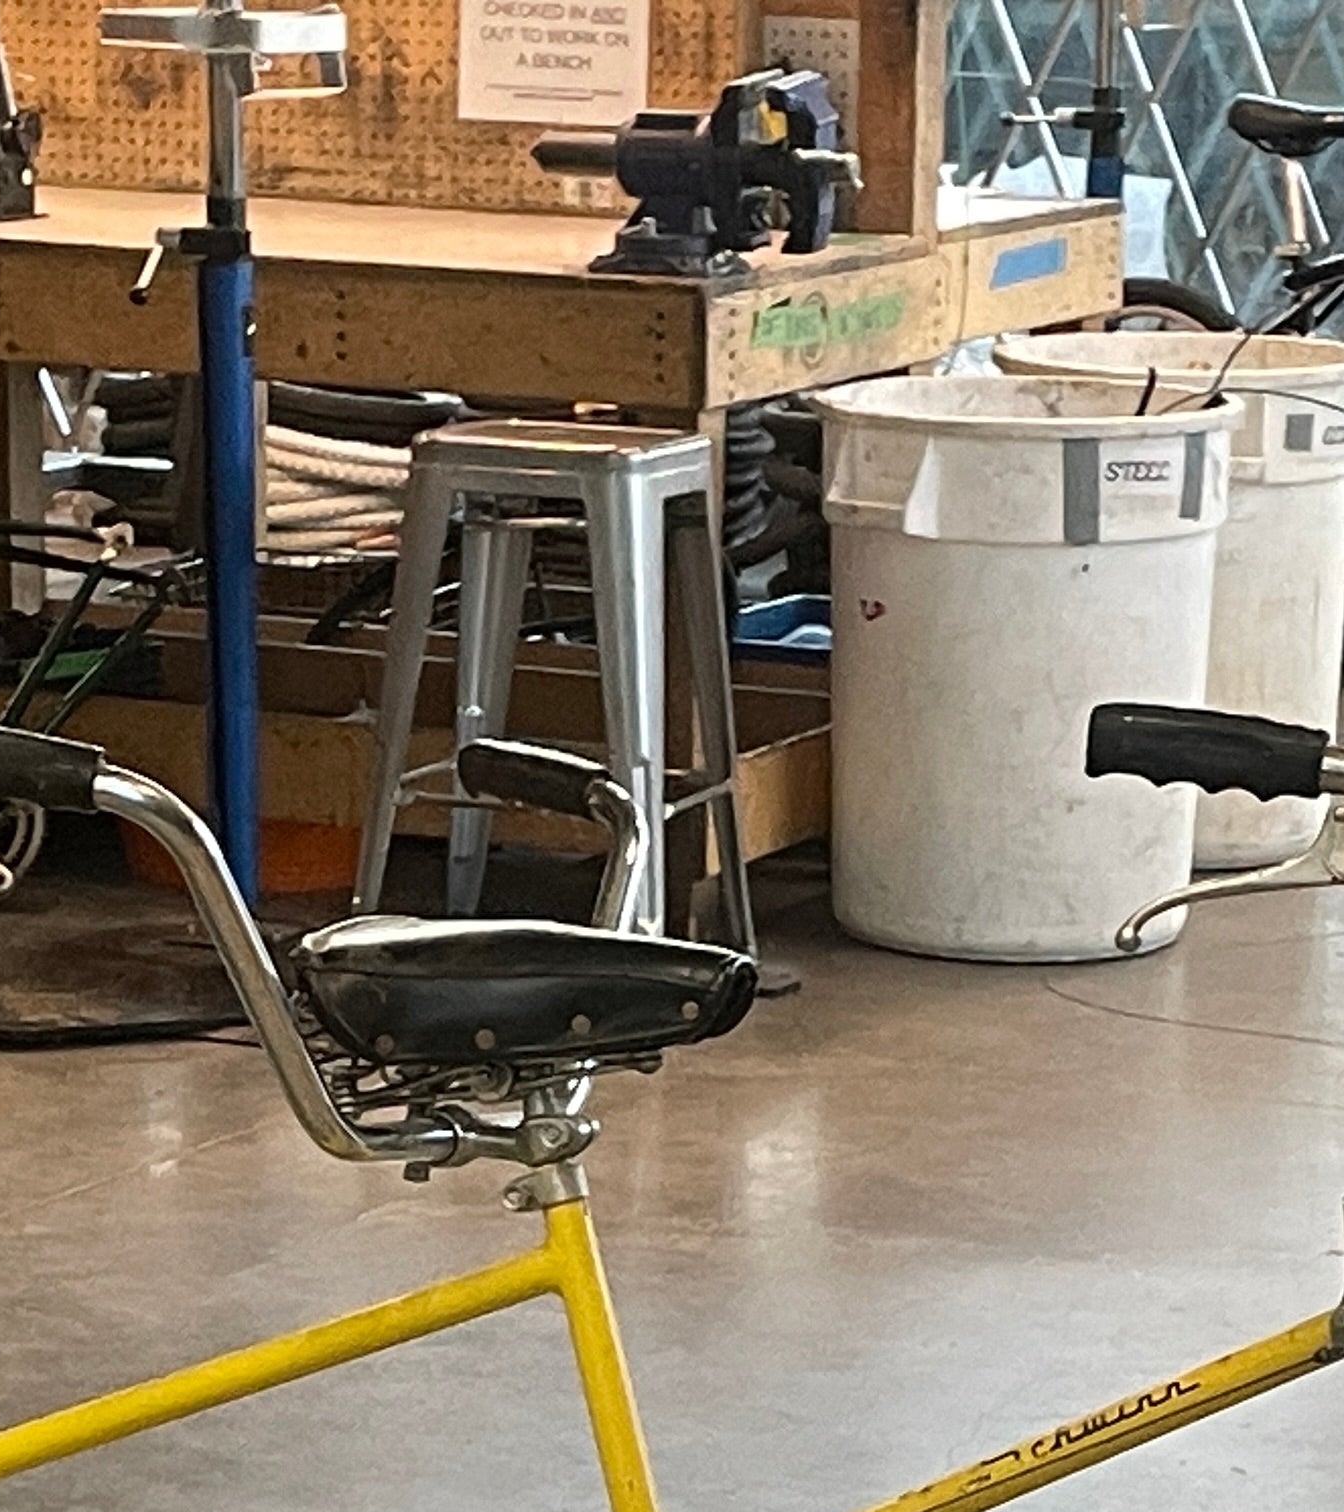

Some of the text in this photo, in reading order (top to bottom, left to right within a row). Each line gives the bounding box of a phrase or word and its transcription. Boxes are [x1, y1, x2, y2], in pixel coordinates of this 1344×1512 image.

[483, 0, 565, 20] CHECKED
[569, 5, 587, 19] IN
[479, 25, 630, 47] OUT TO WORK ON
[516, 53, 592, 70] A BENCH
[1104, 461, 1170, 481] STEEL
